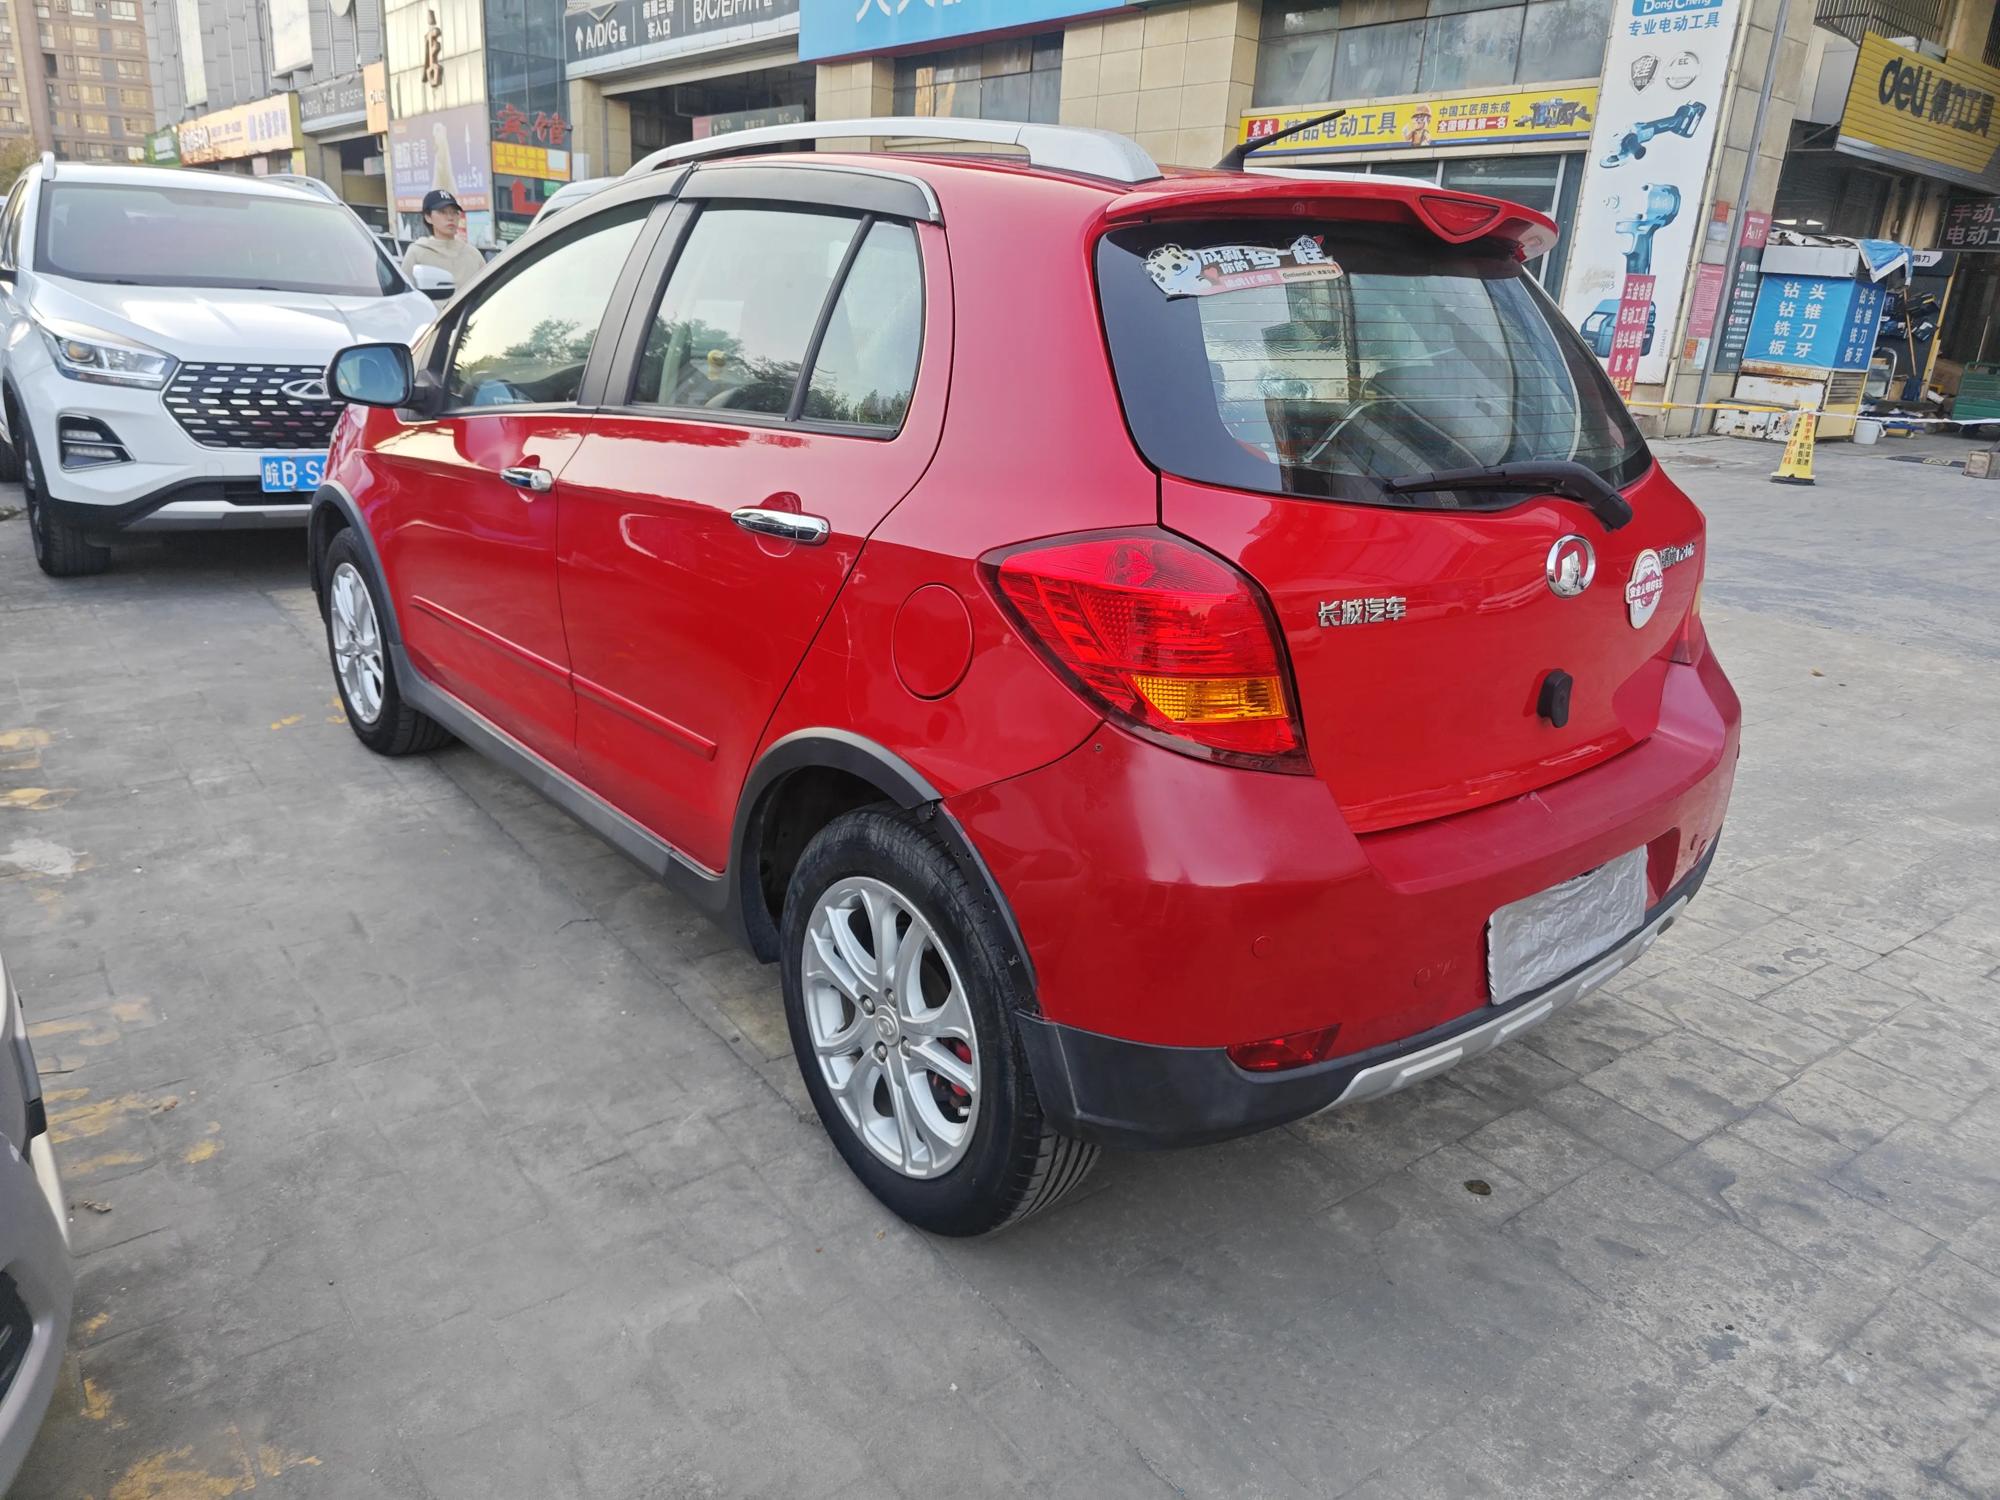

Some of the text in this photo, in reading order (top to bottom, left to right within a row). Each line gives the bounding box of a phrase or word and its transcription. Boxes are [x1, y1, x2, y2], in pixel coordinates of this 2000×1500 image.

[1628, 11, 1720, 36] 专业电动工具
[1878, 57, 1932, 118] deli
[1439, 101, 1511, 117] 中国工匠用东成
[1927, 77, 1995, 138] 得力工具
[497, 103, 567, 145] 宾馆
[1284, 111, 1397, 143] 精品电动工具
[1437, 117, 1508, 133] 全国销量第一名
[1621, 306, 1648, 325] 电动工具
[1318, 596, 1407, 627] 长城汽车
